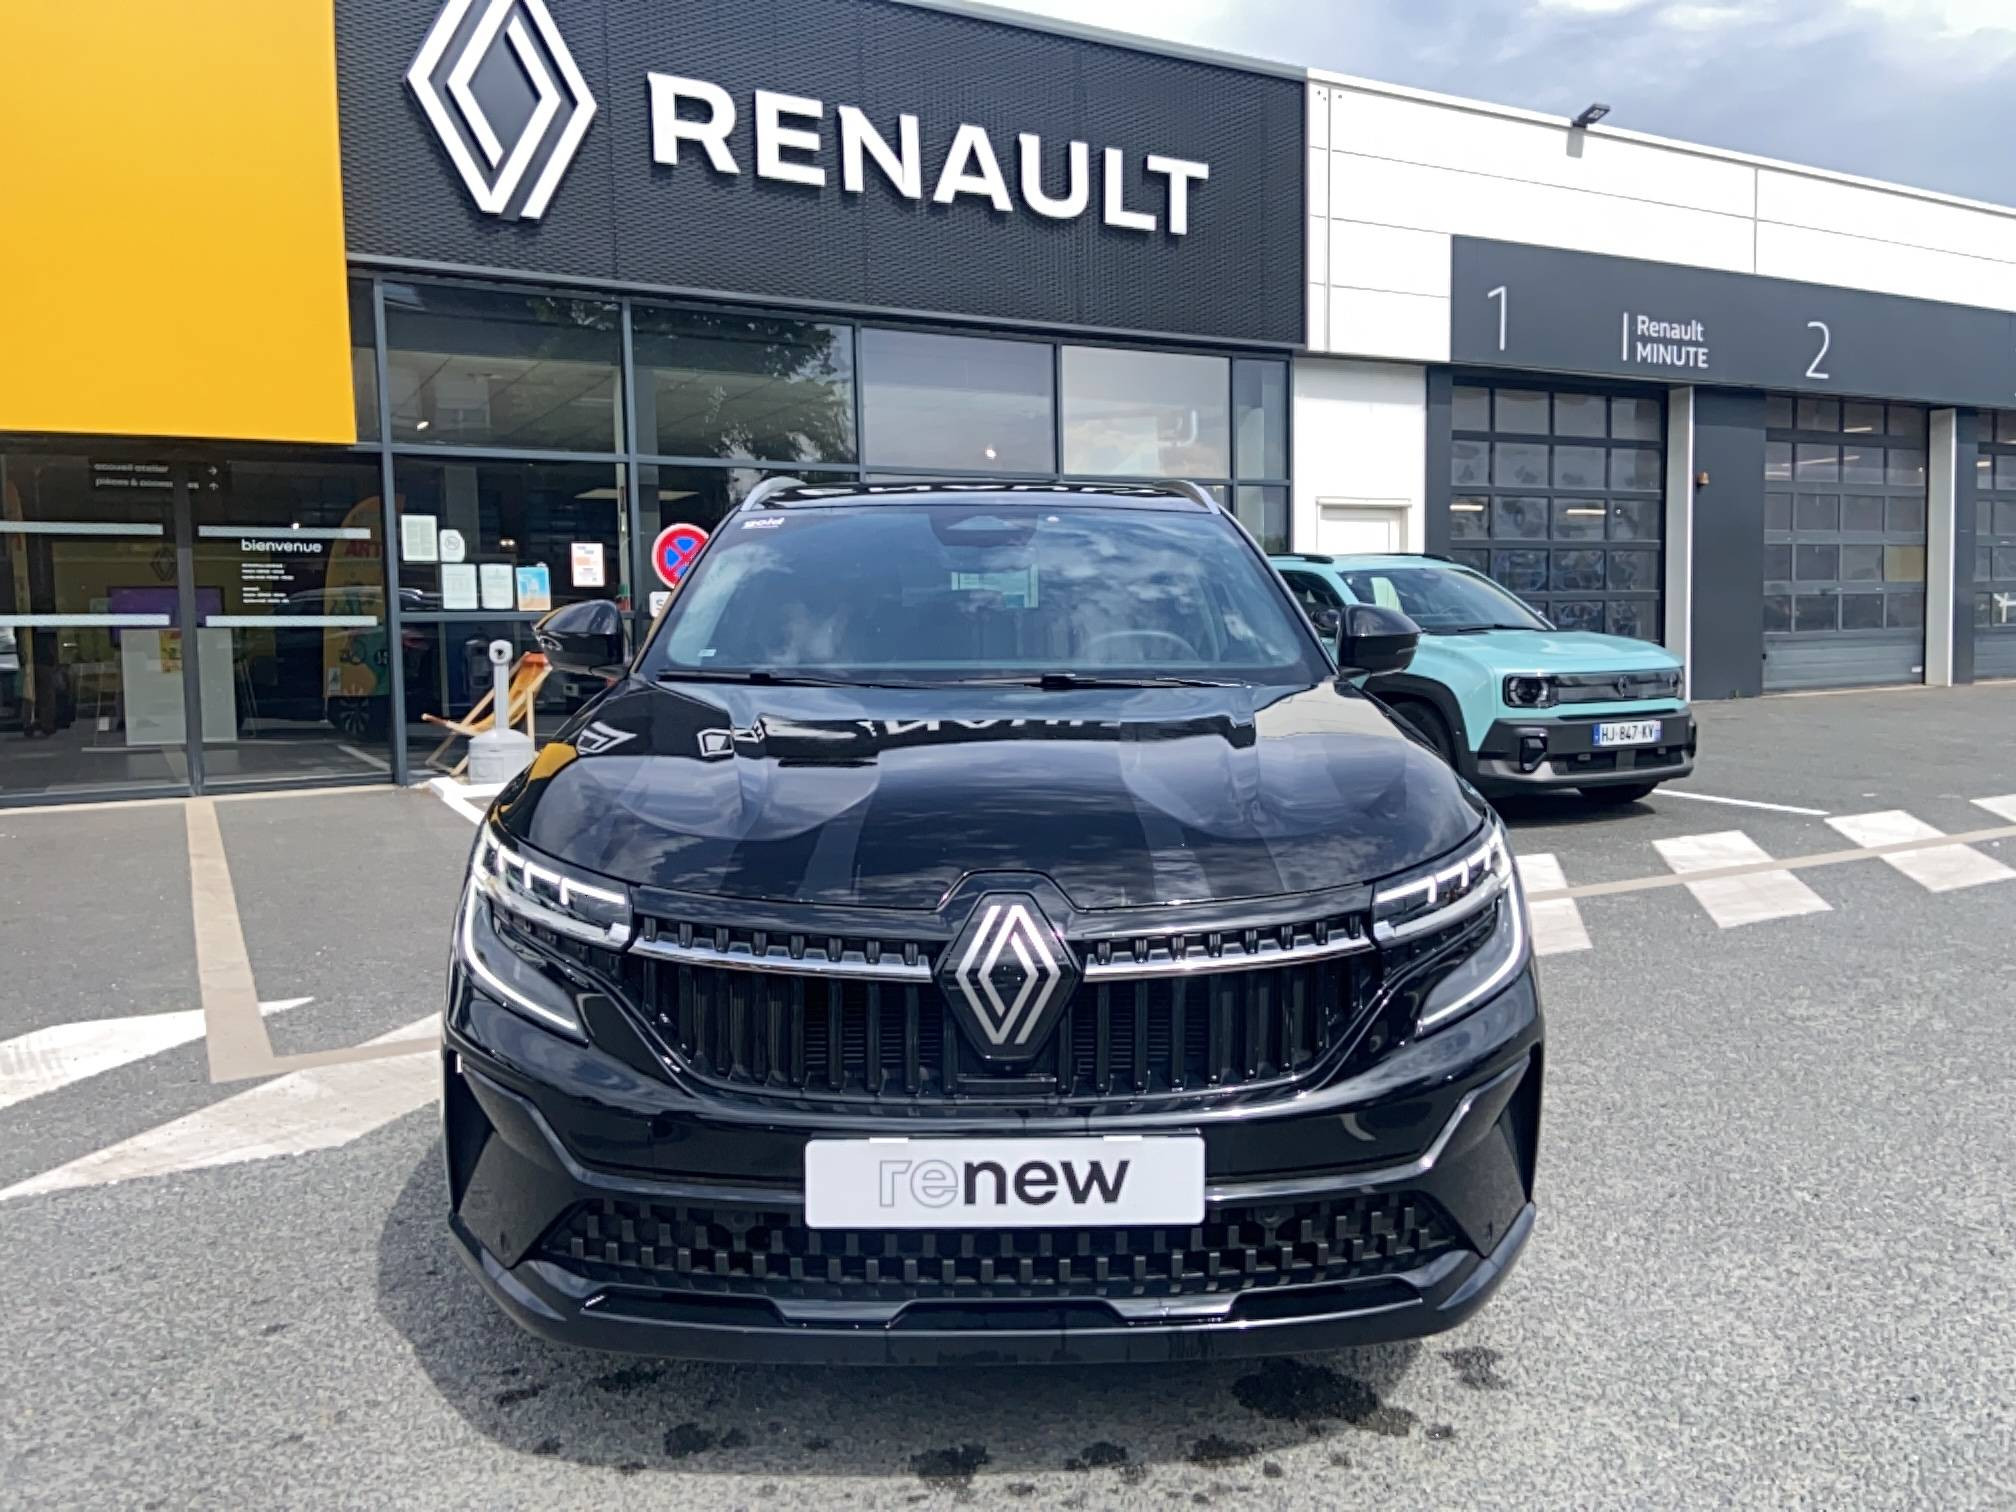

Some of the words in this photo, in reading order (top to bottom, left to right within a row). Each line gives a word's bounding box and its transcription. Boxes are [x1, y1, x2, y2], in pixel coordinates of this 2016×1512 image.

[646, 71, 1210, 236] RENAULT
[1487, 285, 1508, 352] 1
[1636, 314, 1705, 342] Renault
[1636, 342, 1709, 369] MINUTE
[1805, 320, 1830, 380] 2
[240, 538, 323, 553] bienvenue
[878, 1157, 1131, 1208] renew
